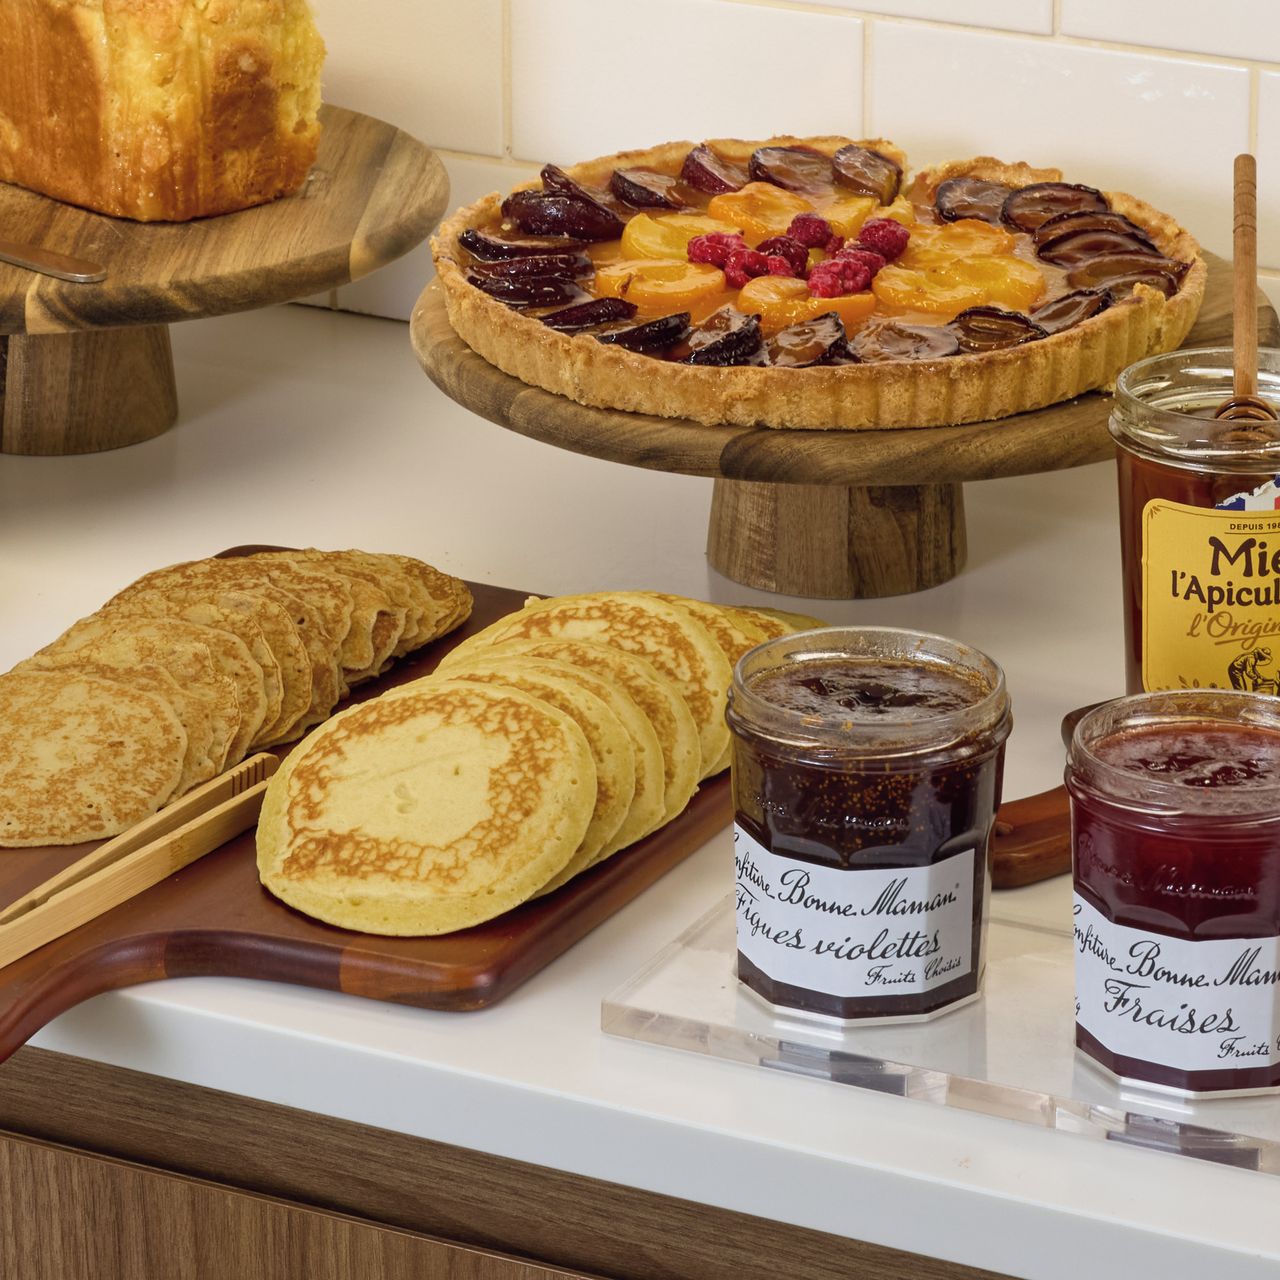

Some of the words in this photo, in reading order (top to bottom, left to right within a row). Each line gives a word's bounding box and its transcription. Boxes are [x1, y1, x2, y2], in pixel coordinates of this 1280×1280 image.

[1229, 523, 1264, 531] DEPUIS
[778, 869, 857, 916] Bonne
[861, 877, 956, 916] Maman
[735, 882, 805, 950] Figues
[810, 928, 941, 960] violettes
[865, 965, 917, 986] Fruits
[924, 957, 961, 981] Choisis
[1126, 940, 1210, 988] Bonne
[1104, 978, 1240, 1035] Fraises
[1217, 1036, 1271, 1059] Fruits
